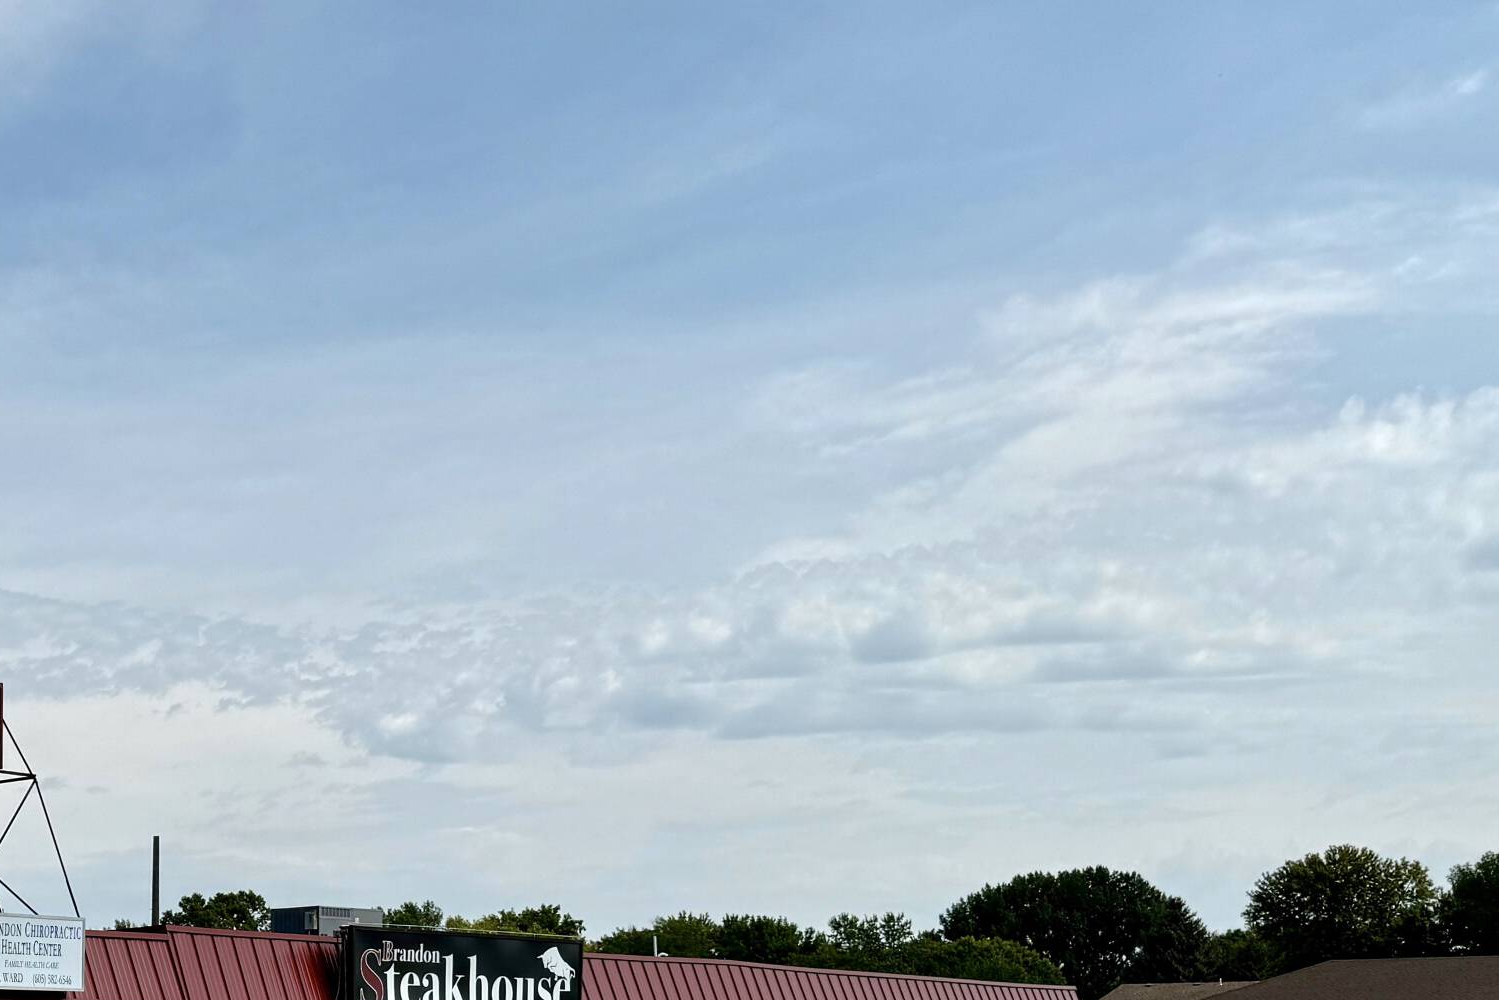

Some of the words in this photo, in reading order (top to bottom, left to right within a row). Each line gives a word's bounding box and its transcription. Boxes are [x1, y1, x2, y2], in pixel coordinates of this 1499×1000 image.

[24, 922, 81, 940] CHIROPRACTIC
[1, 939, 31, 956] HEALTH
[33, 940, 62, 957] CENTER
[382, 940, 441, 964] Brandon
[2, 972, 24, 983] WARD
